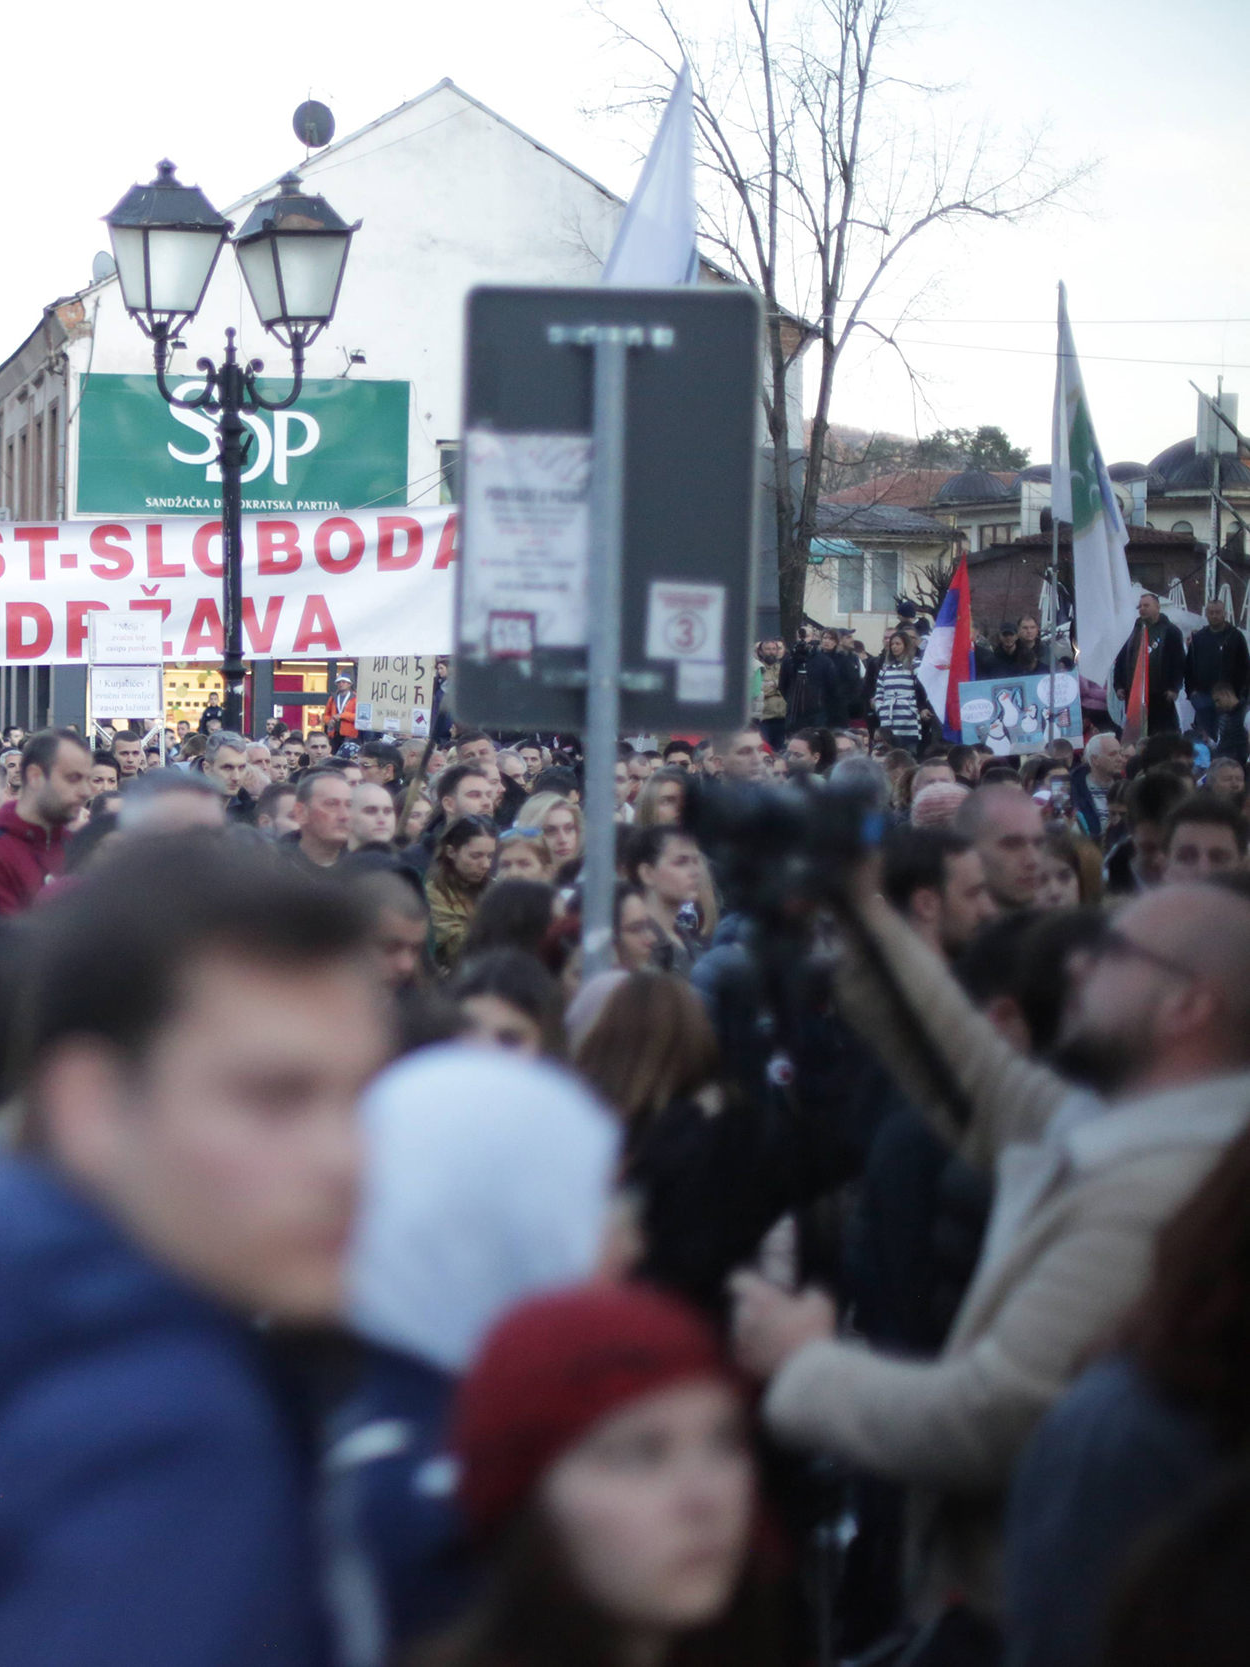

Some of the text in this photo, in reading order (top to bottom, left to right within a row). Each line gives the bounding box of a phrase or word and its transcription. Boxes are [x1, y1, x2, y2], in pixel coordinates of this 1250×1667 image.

[167, 380, 320, 485] SDP
[145, 496, 210, 508] SANDŽAČKA
[296, 500, 341, 511] PARTIJA
